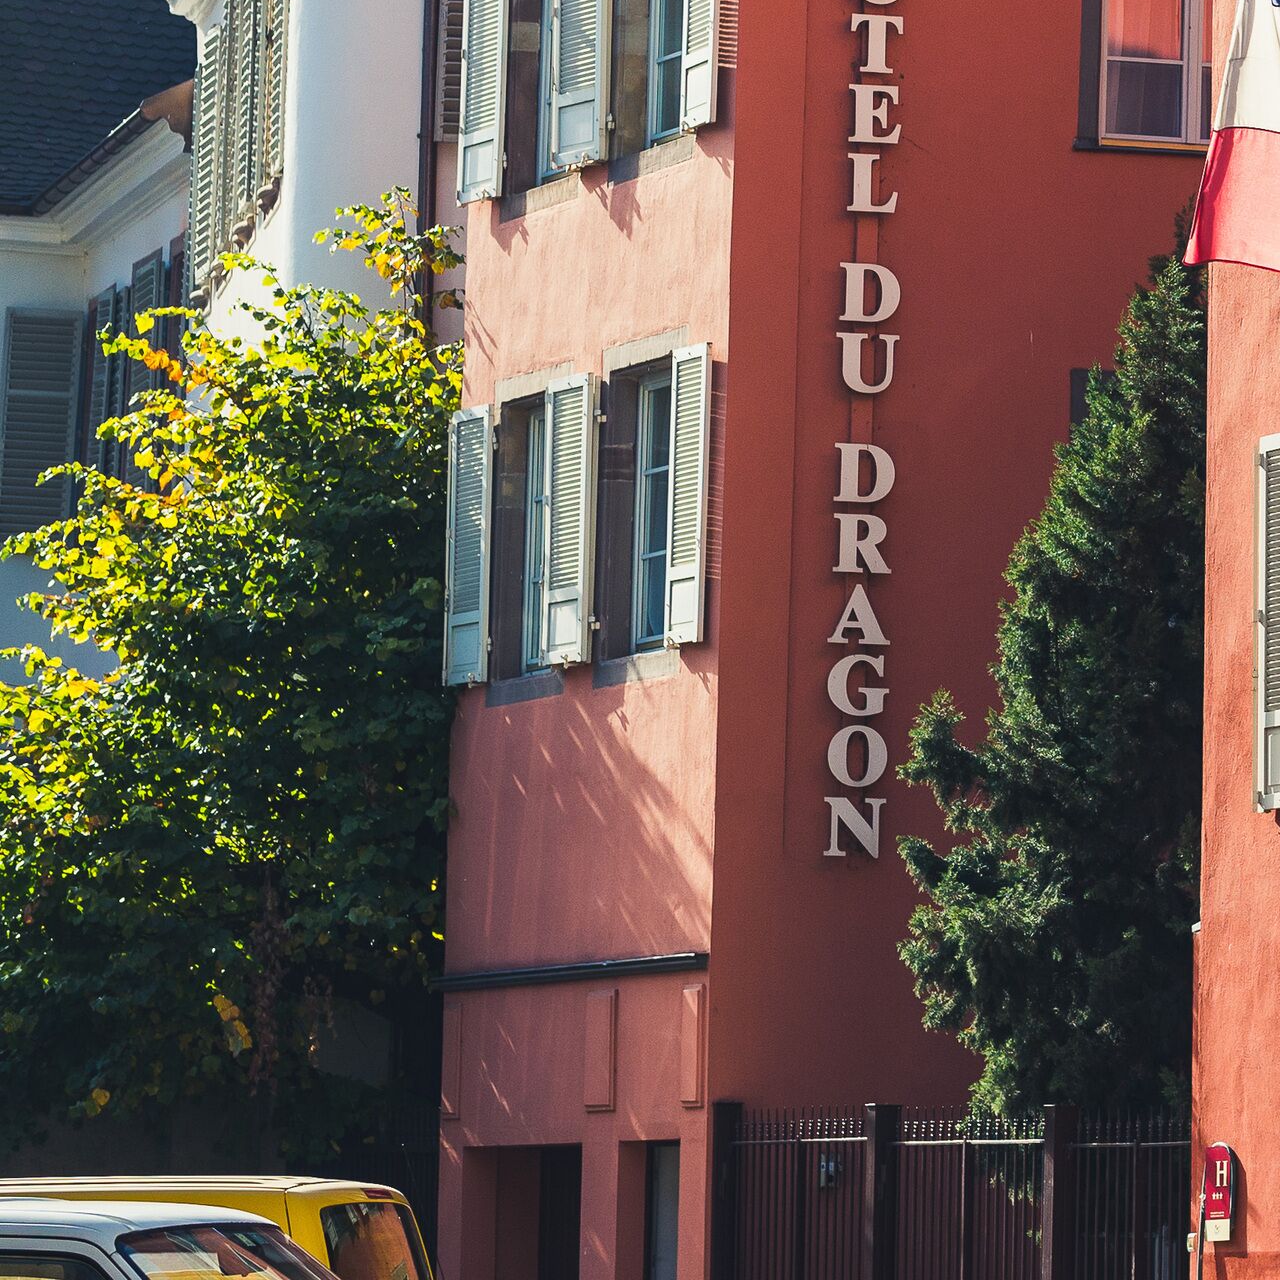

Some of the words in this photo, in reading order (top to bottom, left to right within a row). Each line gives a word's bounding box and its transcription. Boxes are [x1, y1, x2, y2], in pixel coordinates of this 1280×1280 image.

[836, 261, 901, 394] DU
[823, 442, 896, 859] DRAGON
[1215, 1160, 1228, 1187] H
